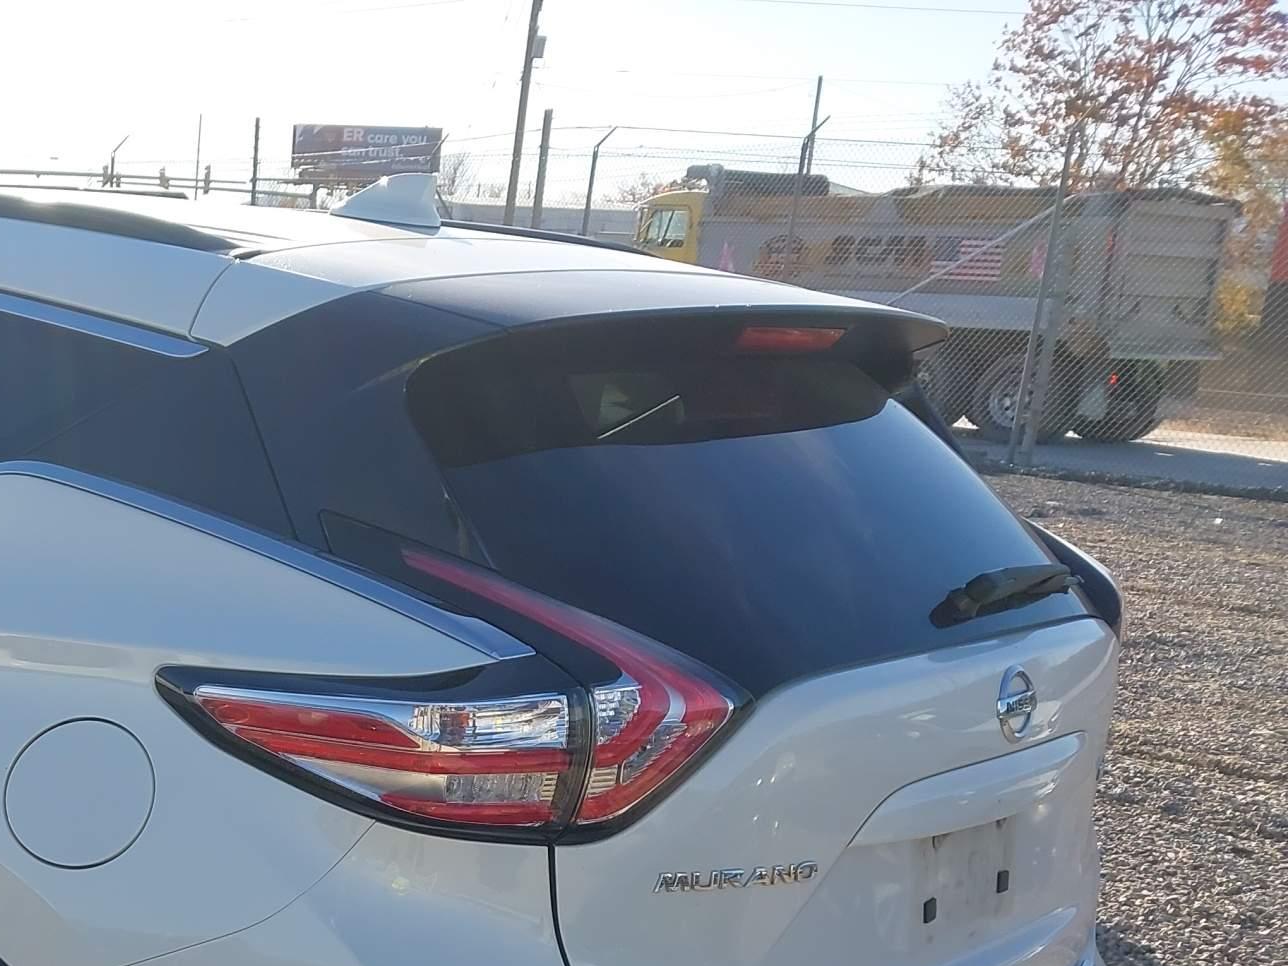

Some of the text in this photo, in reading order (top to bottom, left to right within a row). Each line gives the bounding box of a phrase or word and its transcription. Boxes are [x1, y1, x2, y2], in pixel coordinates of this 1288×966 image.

[343, 128, 428, 146] ER care you
[652, 860, 819, 895] MURANO
